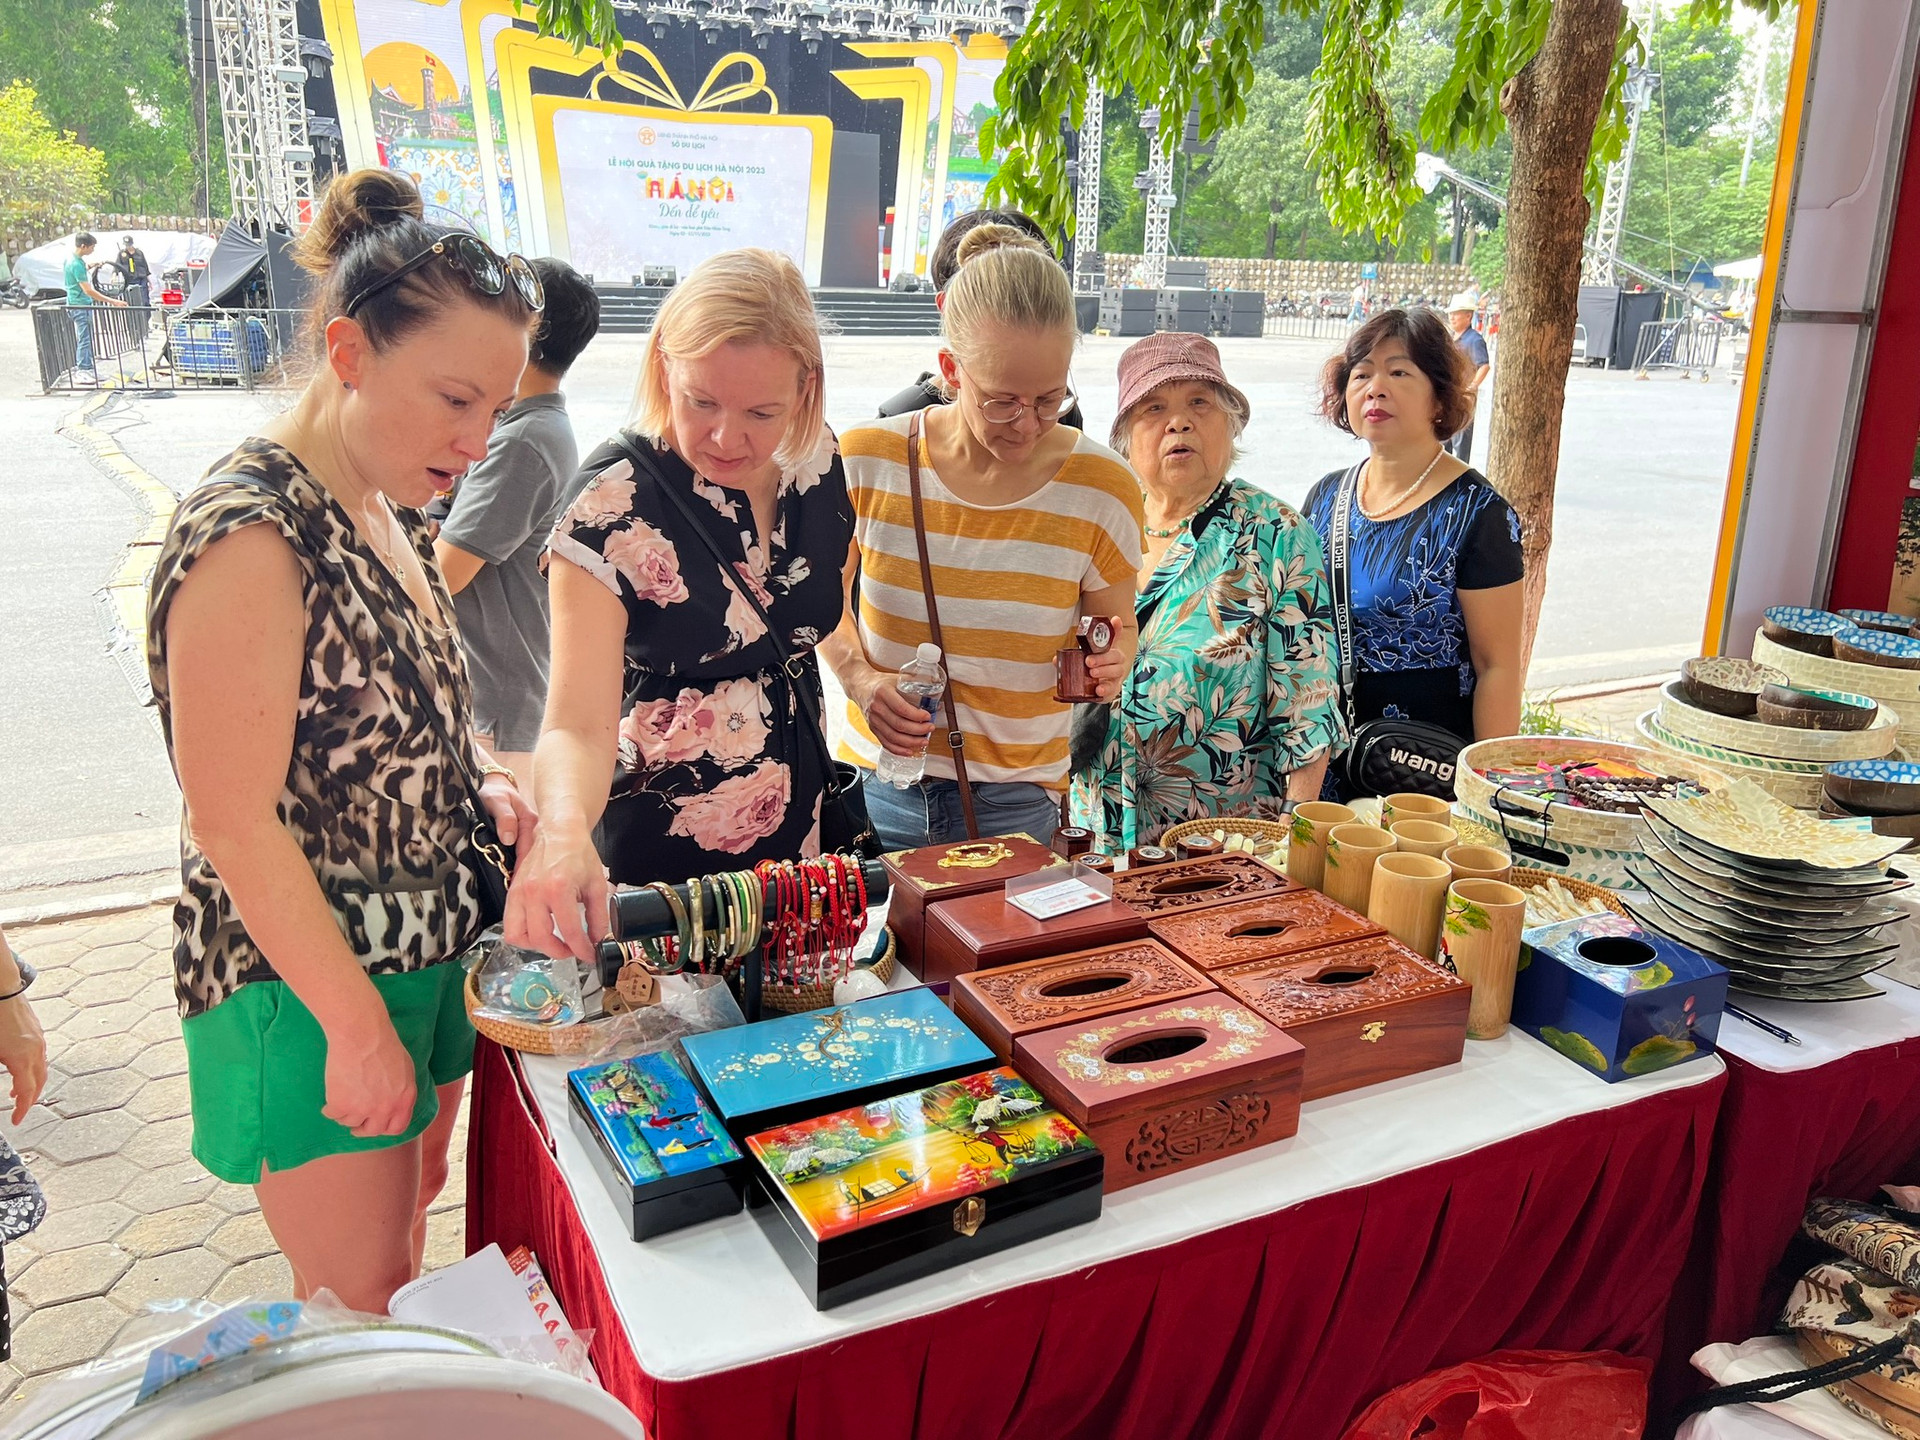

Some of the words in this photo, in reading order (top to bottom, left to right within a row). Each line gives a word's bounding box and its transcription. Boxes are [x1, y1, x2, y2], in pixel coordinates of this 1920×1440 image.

[637, 159, 656, 168] QUÀ
[696, 163, 713, 172] LỊCH
[715, 163, 727, 172] HÀ
[729, 164, 744, 174] NỘI
[746, 166, 765, 174] 2023
[1338, 603, 1348, 630] RODI
[1390, 747, 1455, 782] wang
